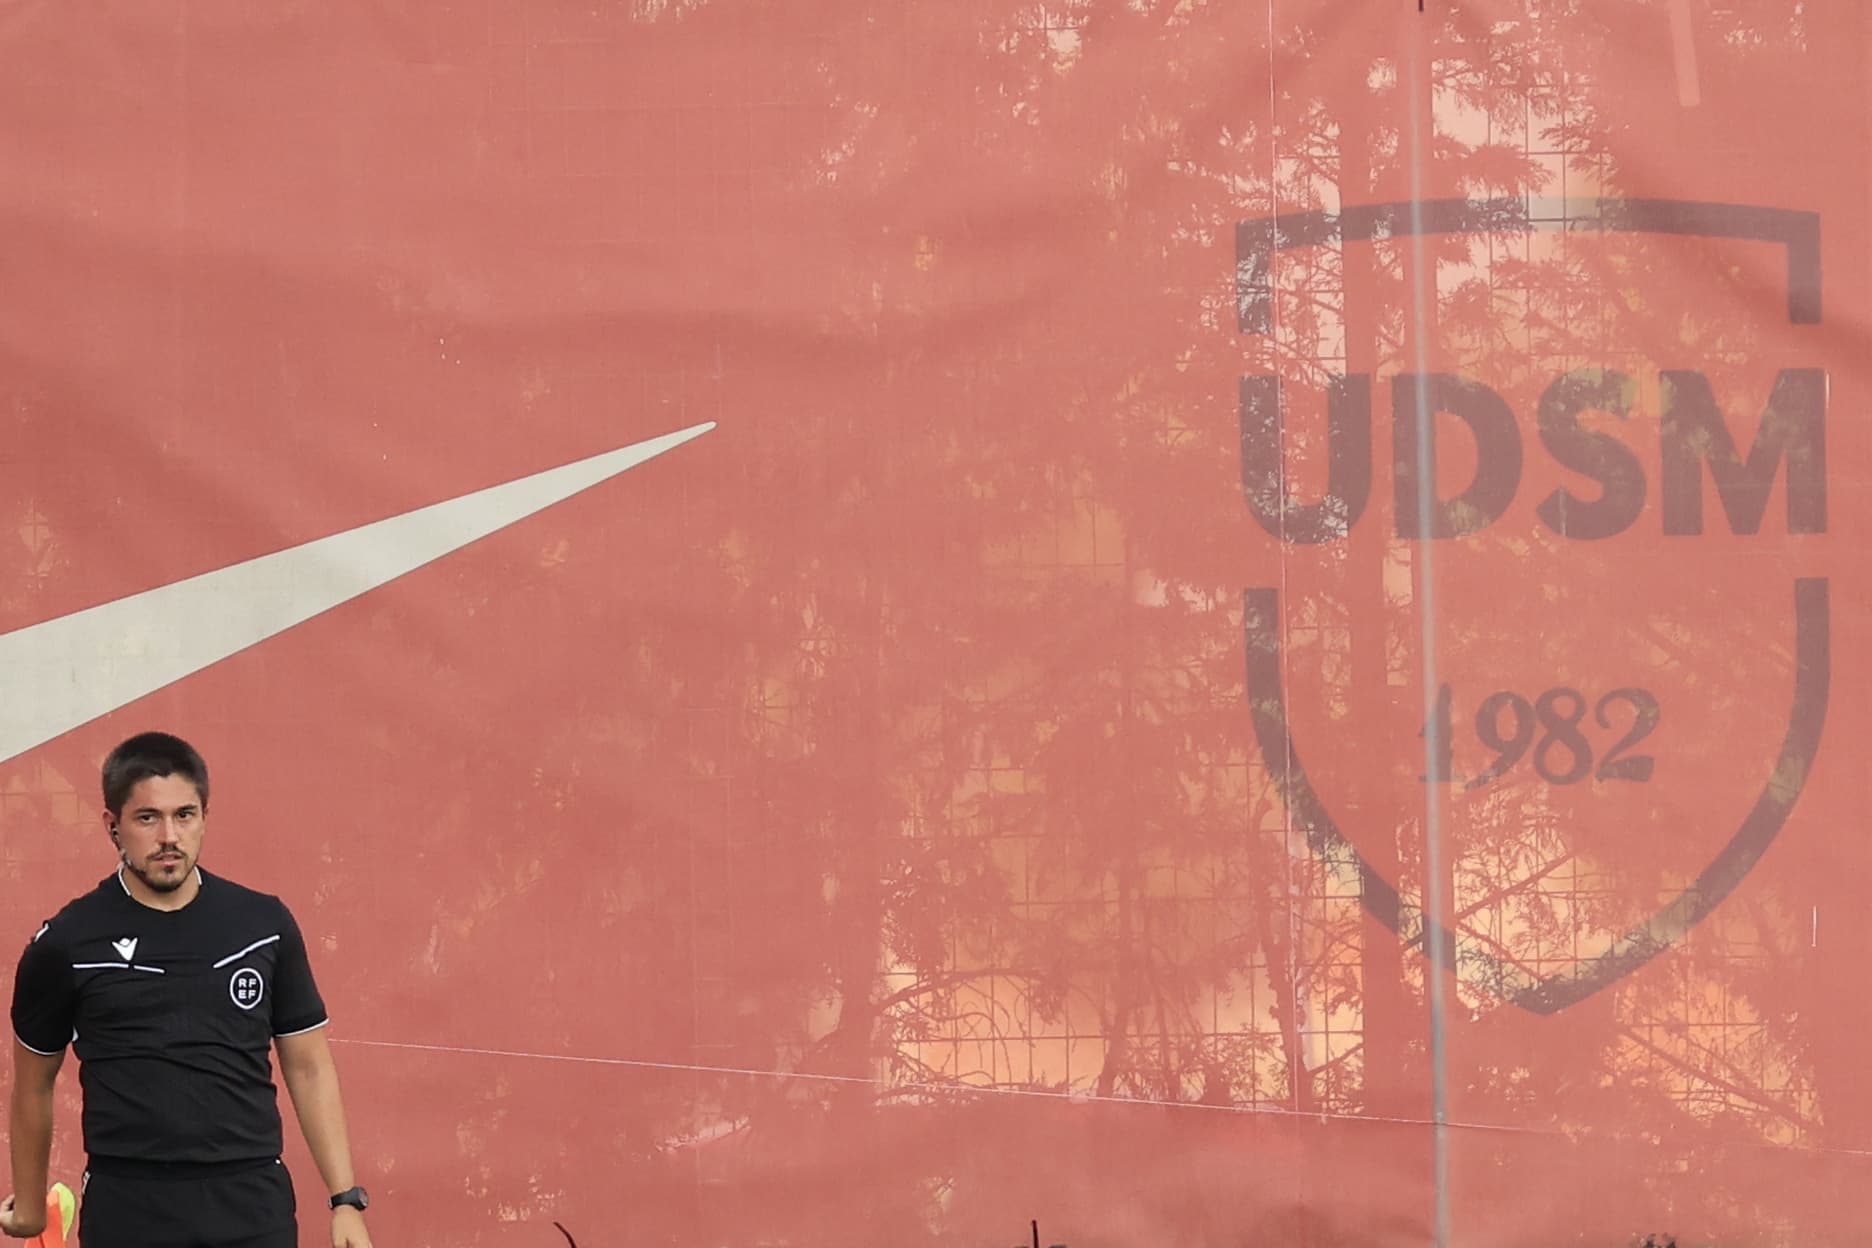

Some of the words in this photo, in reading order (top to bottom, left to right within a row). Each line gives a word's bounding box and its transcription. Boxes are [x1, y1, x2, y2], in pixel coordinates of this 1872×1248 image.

[1240, 367, 1829, 545] UDSM
[1417, 682, 1661, 789] 1982
[238, 978, 257, 989] RF
[238, 989, 257, 1000] EF
